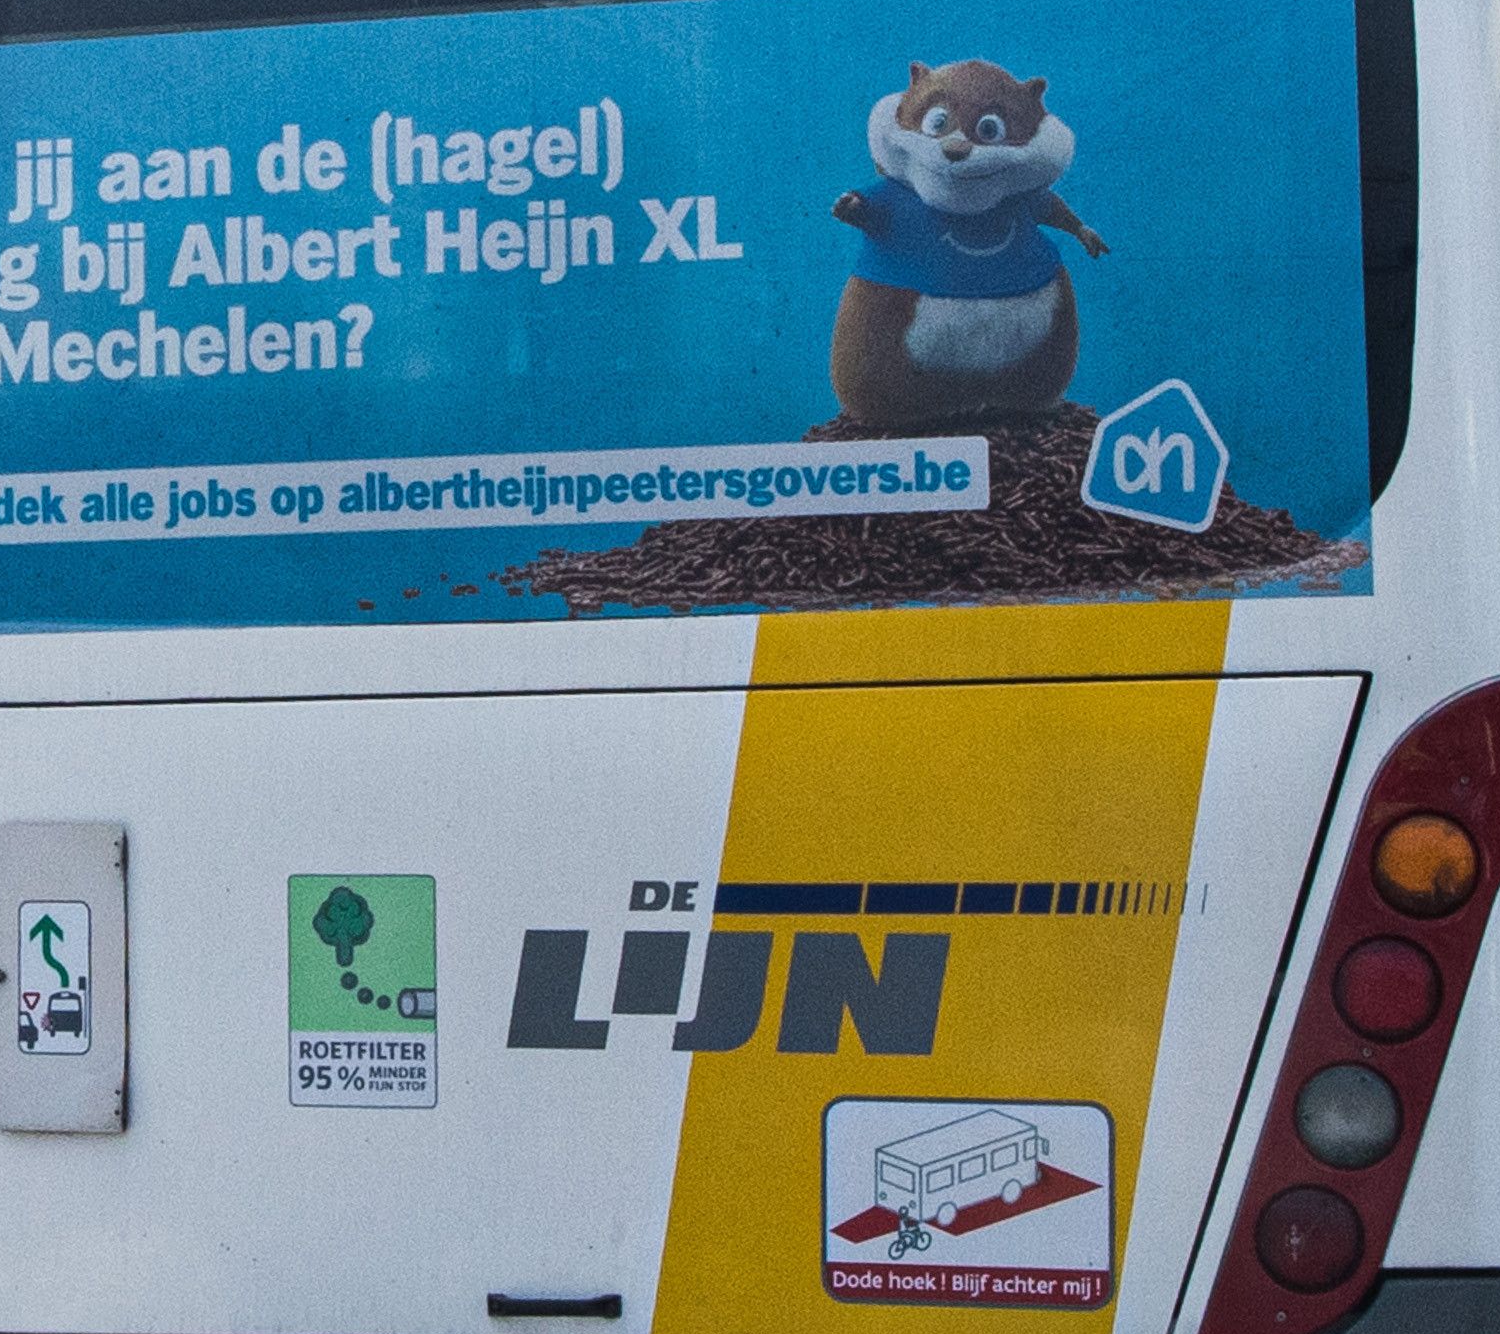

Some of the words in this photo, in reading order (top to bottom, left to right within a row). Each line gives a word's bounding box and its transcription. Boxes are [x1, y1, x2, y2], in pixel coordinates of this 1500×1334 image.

[8, 138, 73, 223] jij
[98, 146, 231, 203] aan
[256, 124, 347, 194] de
[371, 96, 624, 204] (hagel)
[62, 222, 145, 305] bij
[169, 214, 401, 288] Albert
[425, 199, 614, 285] Heijn
[639, 196, 743, 263] XL
[80, 482, 154, 524] alle
[165, 478, 257, 529] jobs
[270, 483, 325, 522] op
[337, 450, 972, 516] albertheijnpeetersgovers.be
[629, 880, 699, 912] DE
[507, 929, 951, 1056] LIJN
[299, 1040, 427, 1061] ROETFILTER
[368, 1066, 427, 1080] MINDER
[368, 1080, 394, 1092] FIJN
[398, 1080, 427, 1092] STOF
[832, 1270, 883, 1290] Dode
[951, 1272, 990, 1298] Blijf
[992, 1274, 1058, 1295] achter
